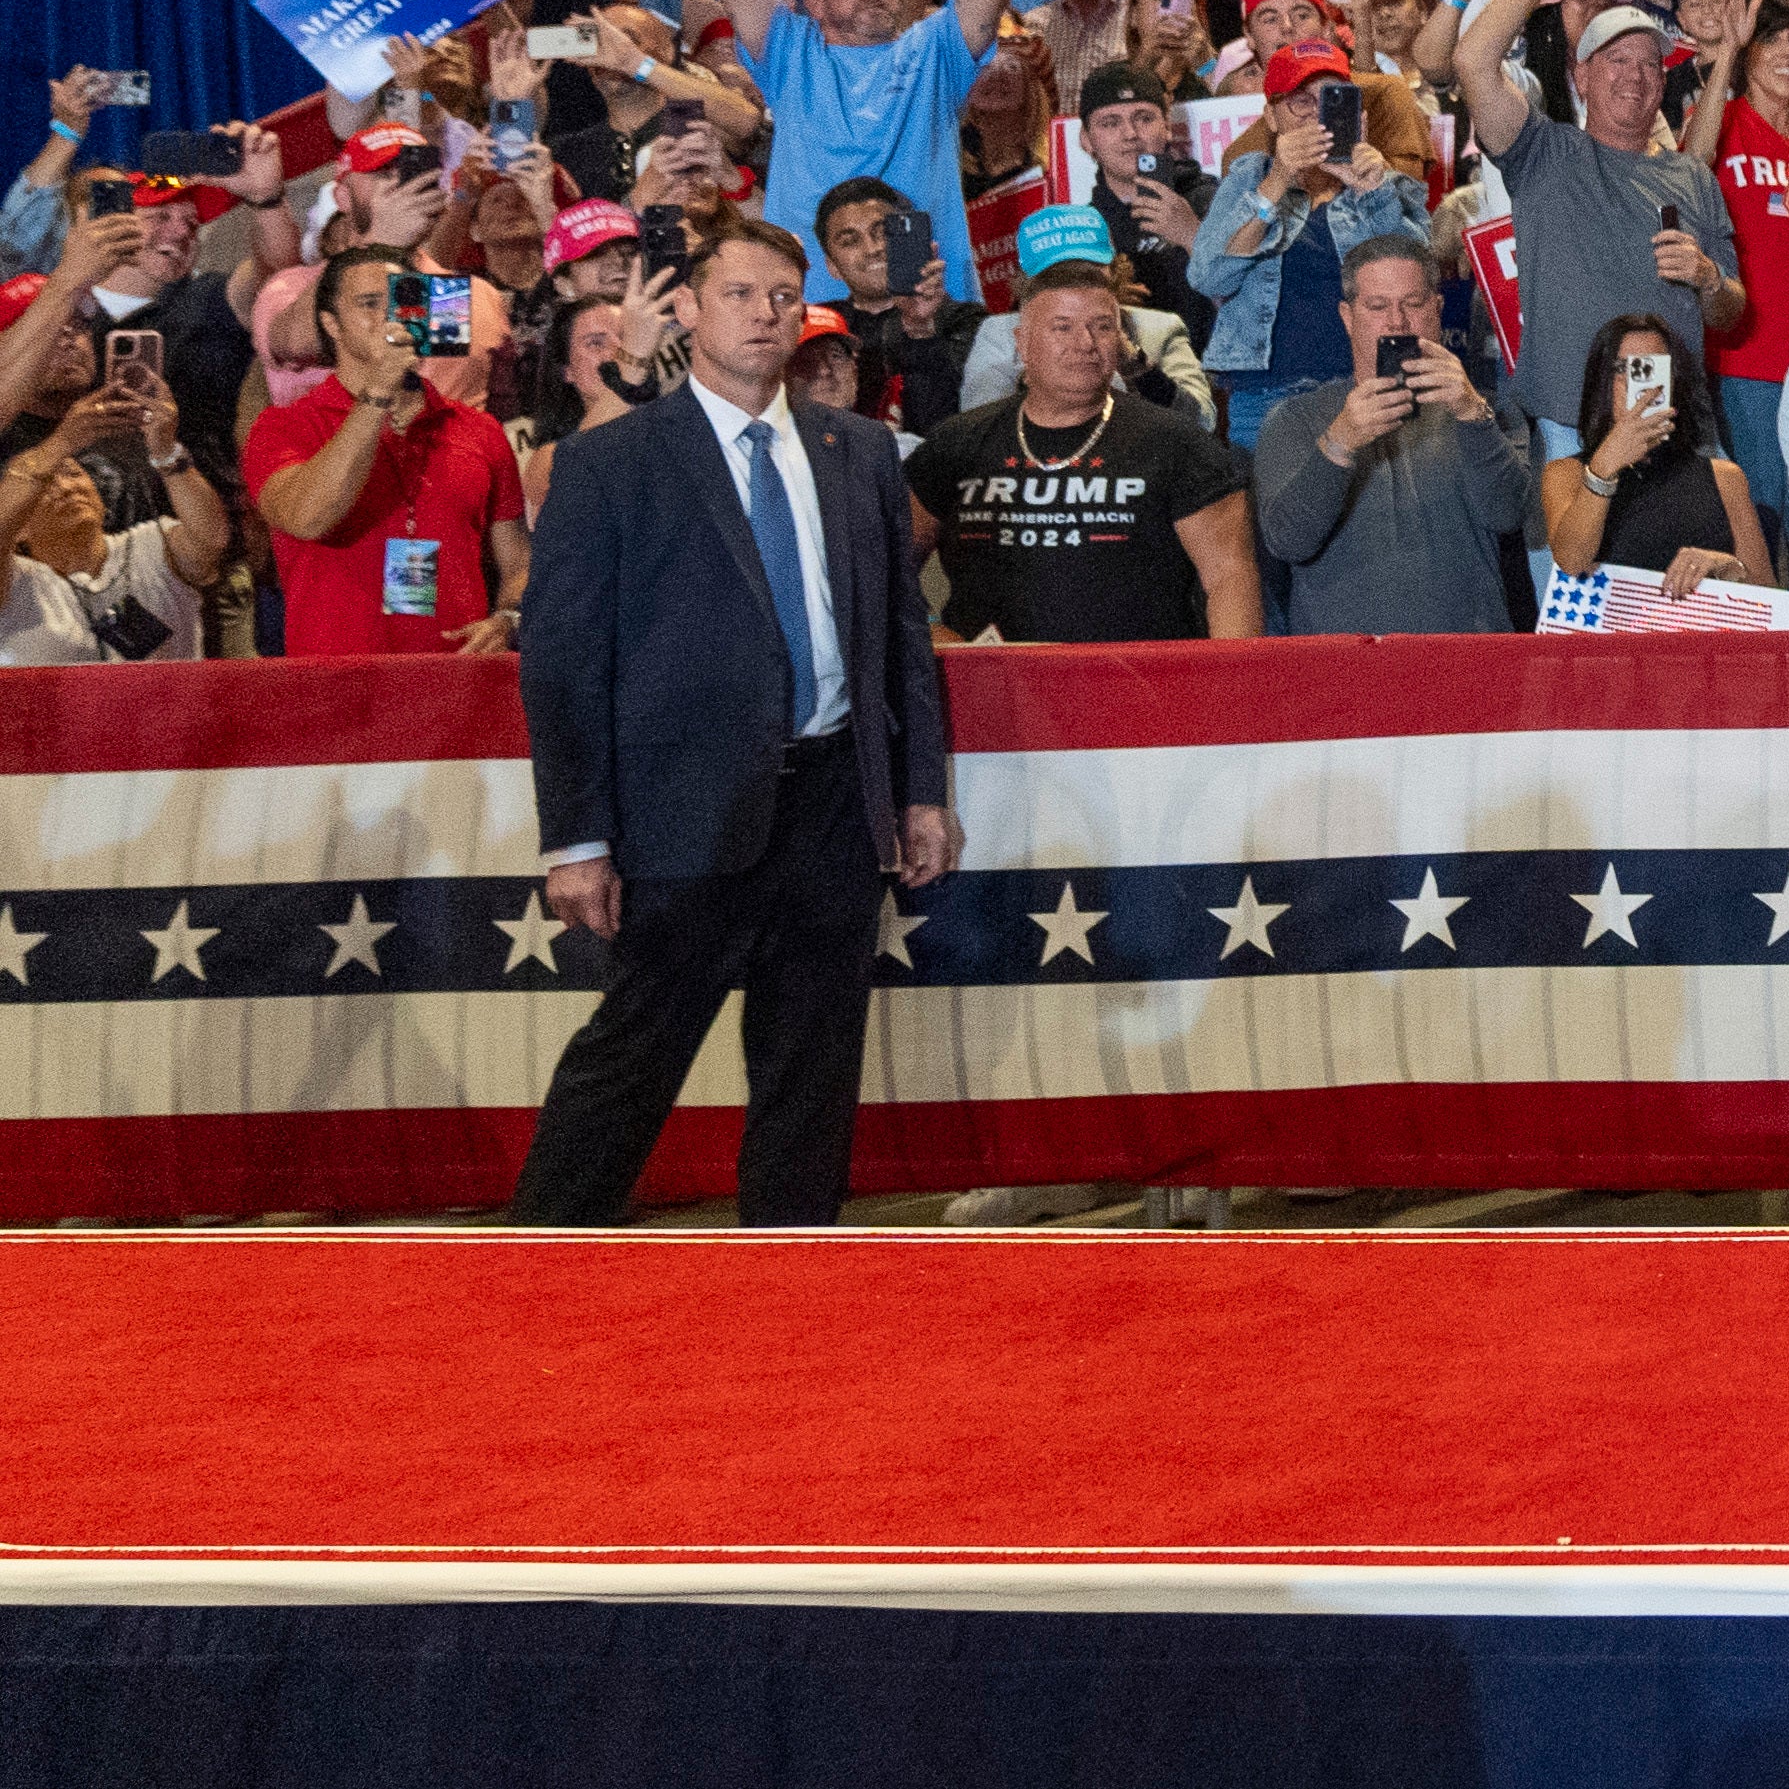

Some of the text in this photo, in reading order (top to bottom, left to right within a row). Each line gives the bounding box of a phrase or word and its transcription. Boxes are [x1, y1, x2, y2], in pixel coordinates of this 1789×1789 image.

[958, 476, 1146, 506] TRUMP
[998, 512, 1079, 525] AMERICA
[1083, 512, 1136, 525] BACK!
[999, 529, 1082, 547] 2024
